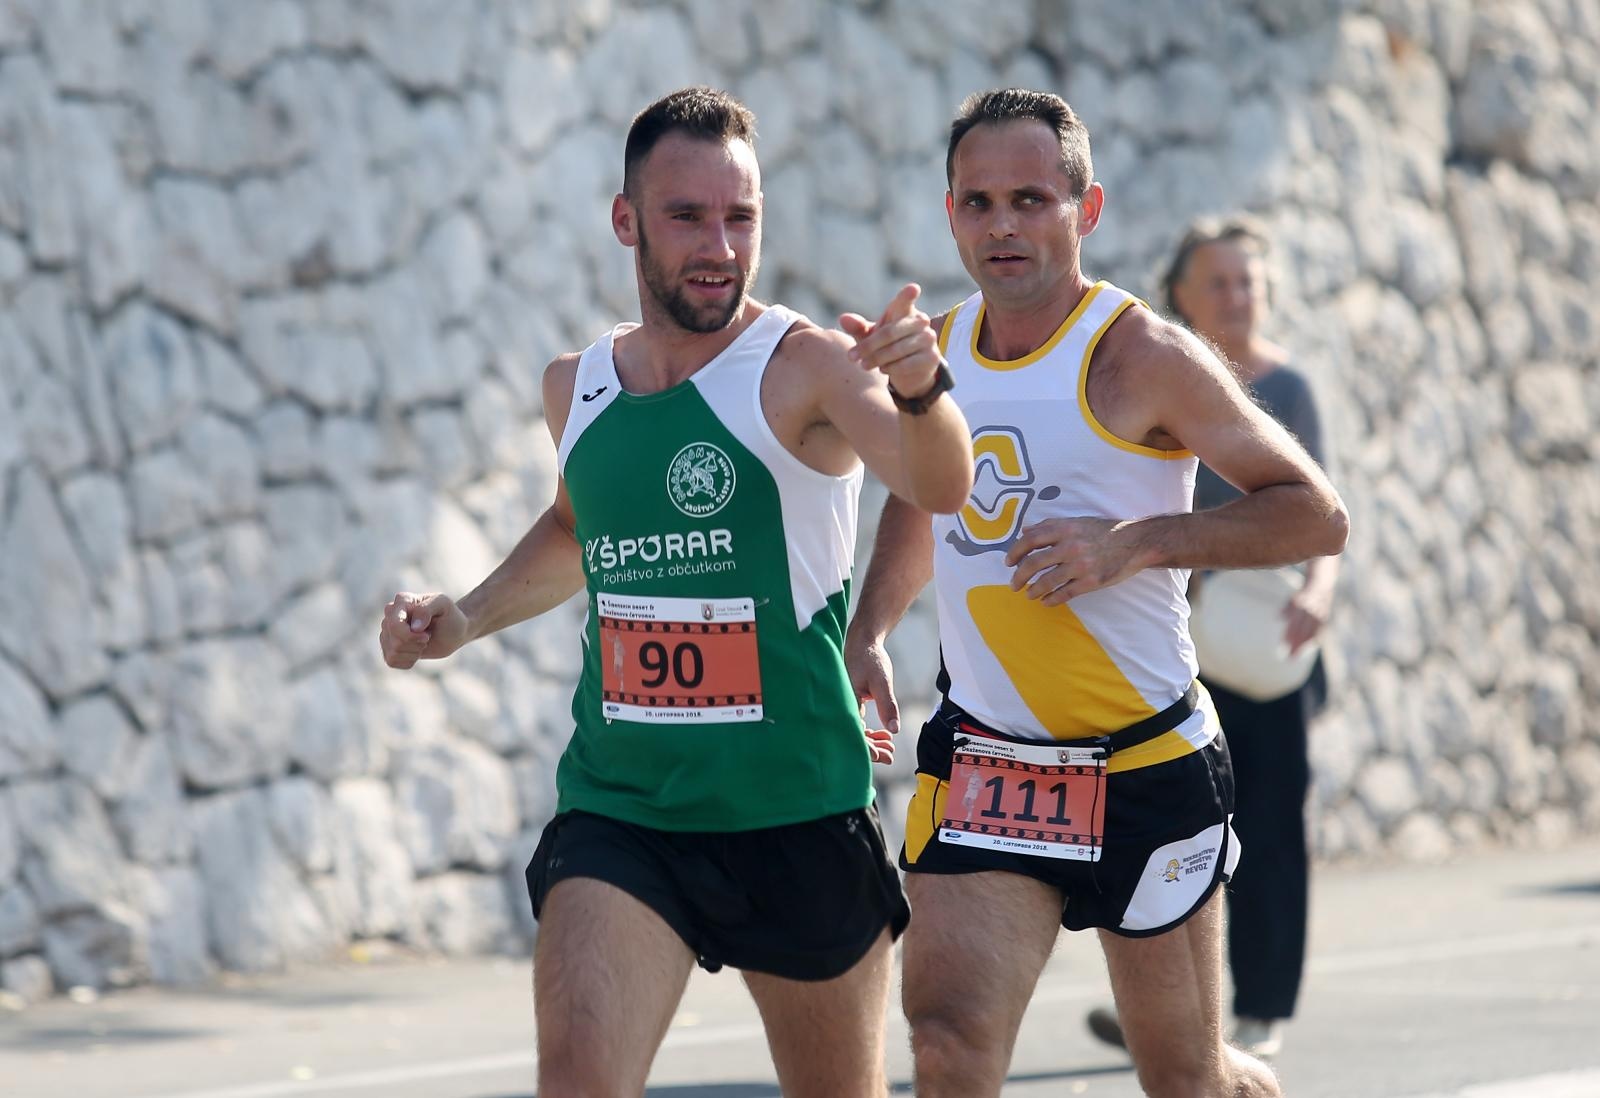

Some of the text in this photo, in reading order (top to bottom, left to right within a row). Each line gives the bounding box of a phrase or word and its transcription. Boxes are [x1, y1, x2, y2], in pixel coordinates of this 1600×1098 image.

[600, 528, 733, 569] ŠPORAR
[603, 559, 737, 586] Pohištvo z občutkom
[639, 640, 704, 689] 90
[980, 775, 1072, 826] 111
[1185, 863, 1208, 875] REVOZ
